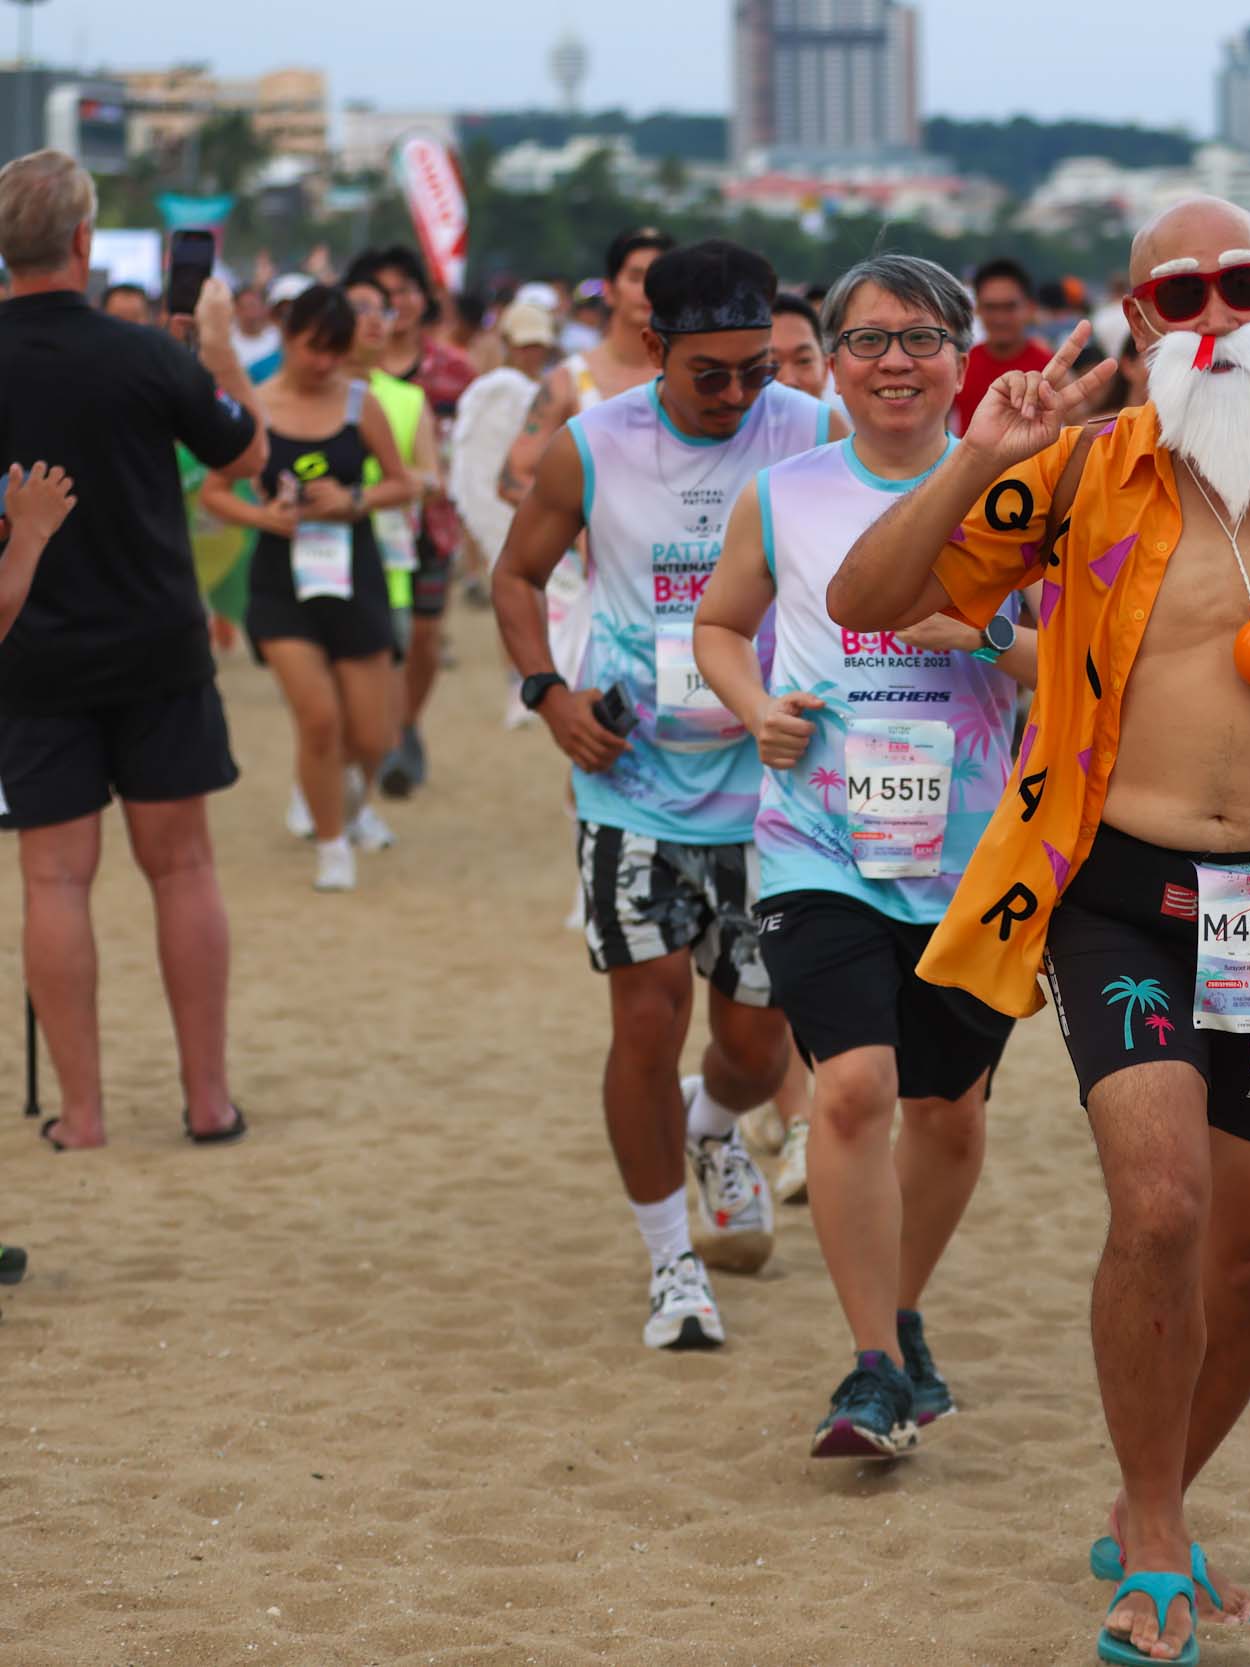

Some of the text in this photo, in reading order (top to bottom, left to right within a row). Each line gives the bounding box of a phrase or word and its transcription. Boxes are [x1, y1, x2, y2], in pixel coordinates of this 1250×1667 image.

[984, 479, 1034, 531] Q
[652, 541, 722, 562] PATTA
[652, 562, 718, 574] INTERNAT
[655, 604, 693, 615] BEACH
[844, 657, 951, 668] BEACH RACE 2023
[848, 690, 953, 703] SKECHERS
[848, 776, 941, 801] M 5515
[980, 882, 1038, 941] R
